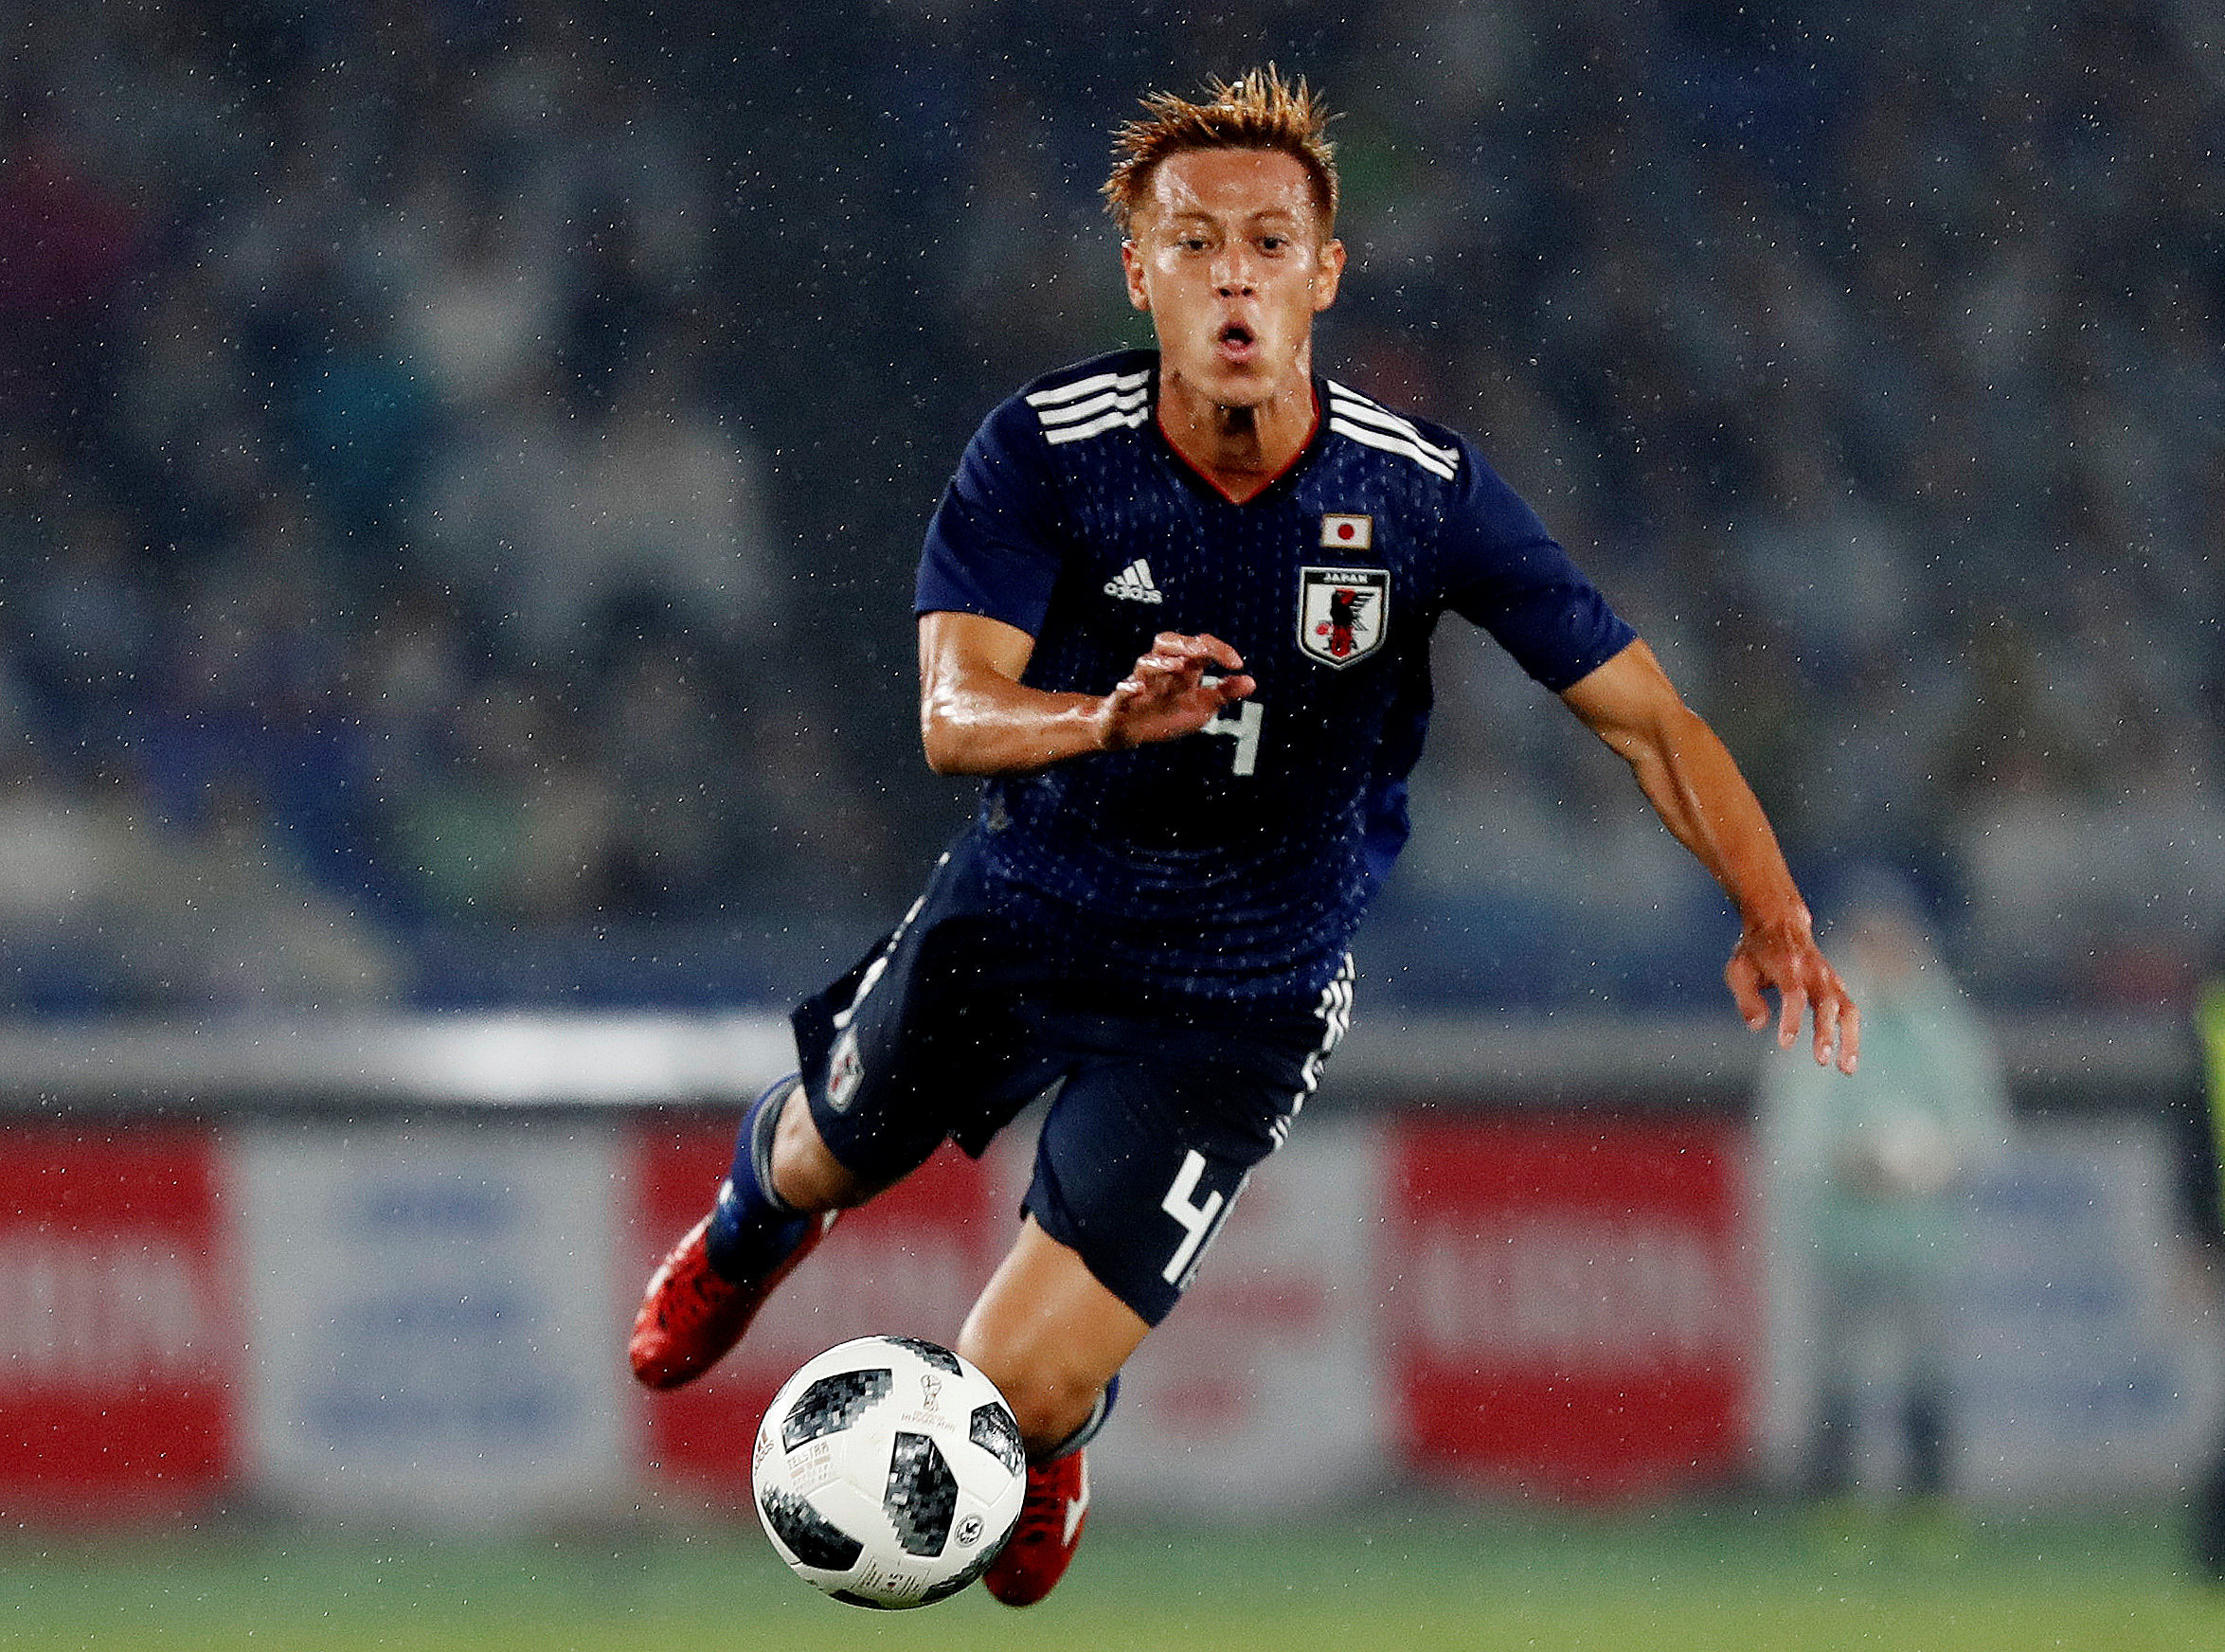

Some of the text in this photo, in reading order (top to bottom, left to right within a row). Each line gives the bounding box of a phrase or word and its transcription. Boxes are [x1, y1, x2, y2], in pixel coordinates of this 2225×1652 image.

[1103, 582, 1163, 604] adidas
[1323, 572, 1368, 584] JAPAN
[1200, 675, 1264, 776] 4
[1161, 1149, 1224, 1284] 4
